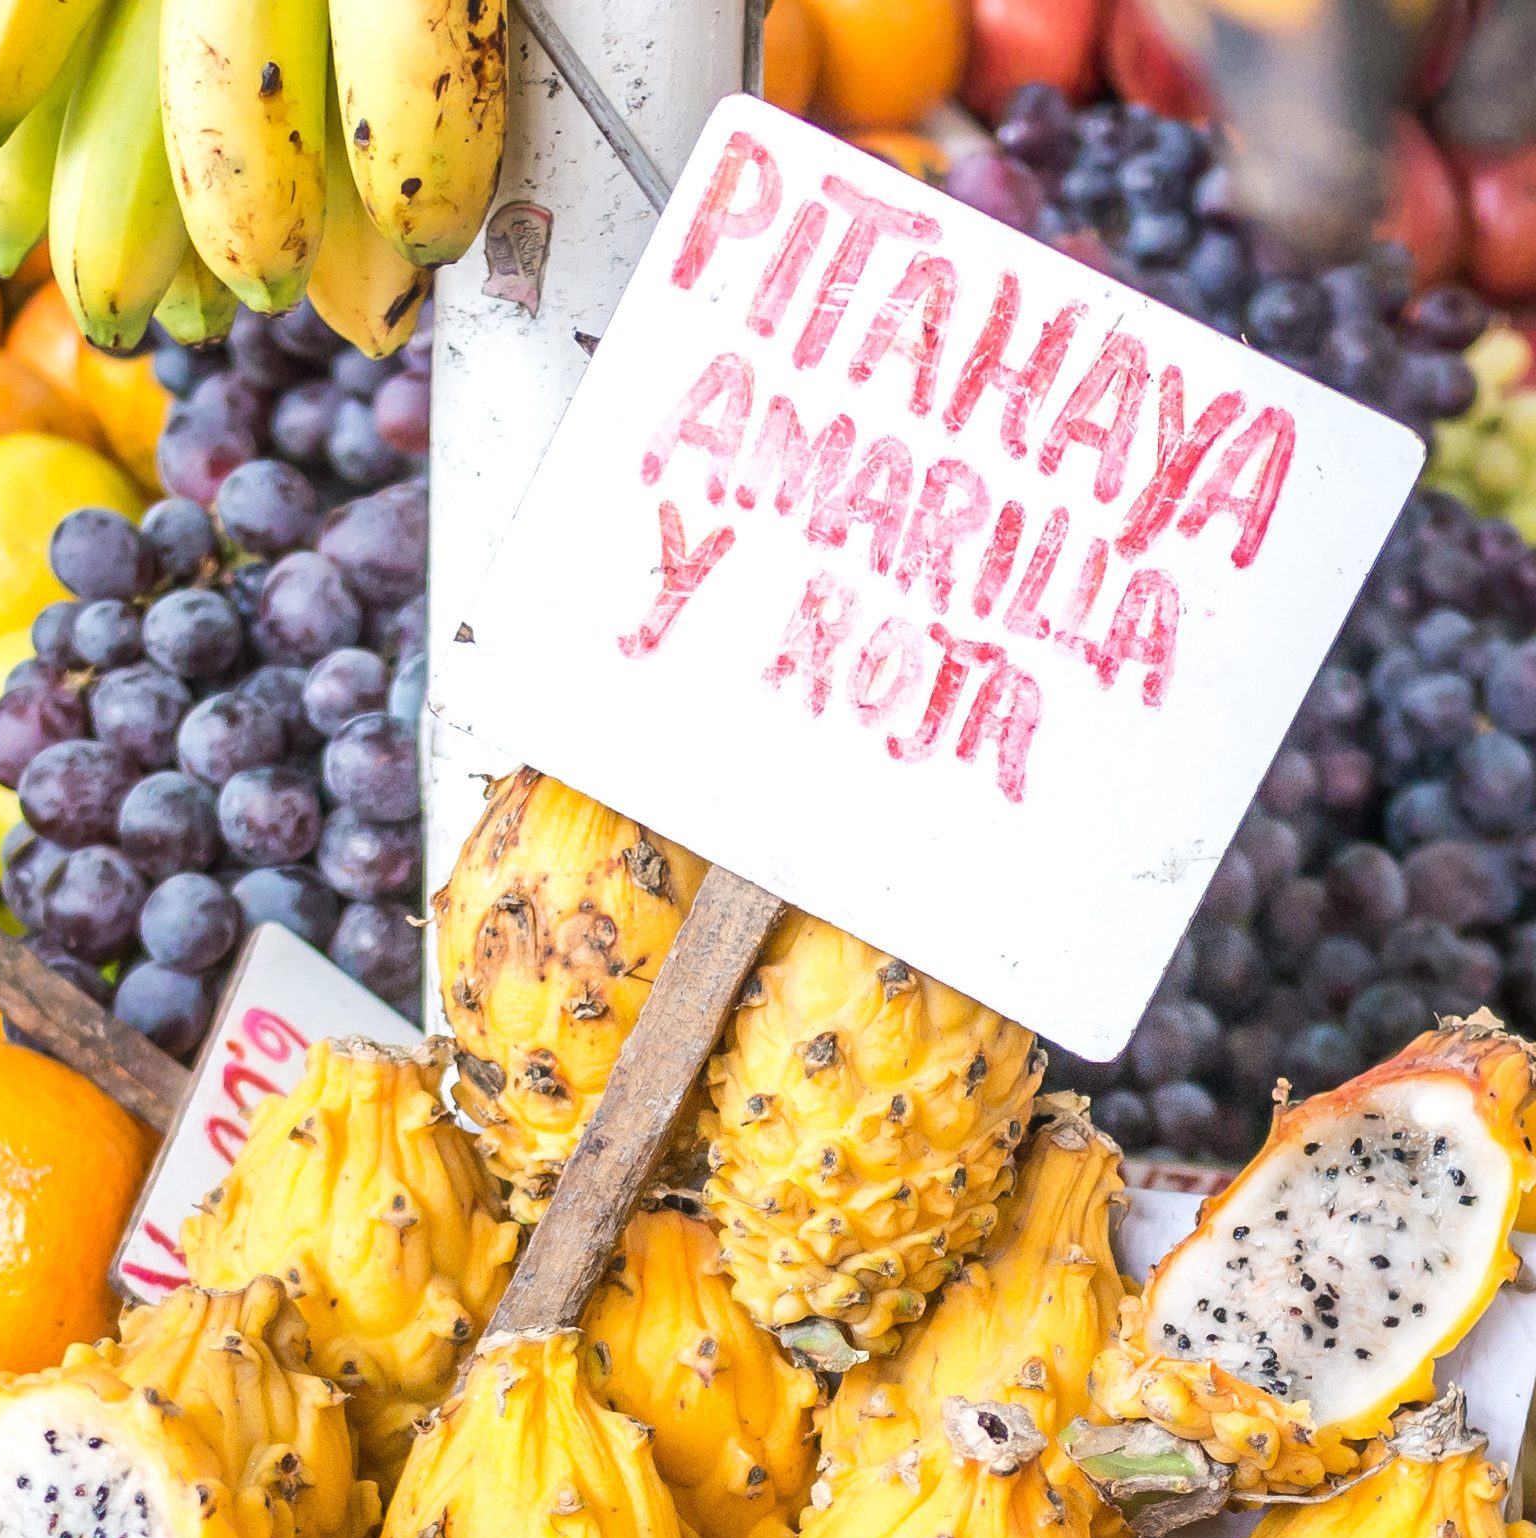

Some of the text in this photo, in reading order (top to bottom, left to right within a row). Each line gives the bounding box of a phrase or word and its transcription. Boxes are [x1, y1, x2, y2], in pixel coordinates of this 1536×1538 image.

[670, 130, 1297, 571] PITAHAYA
[616, 500, 1043, 804] Y ROJA
[640, 351, 1181, 709] AMARILLA
